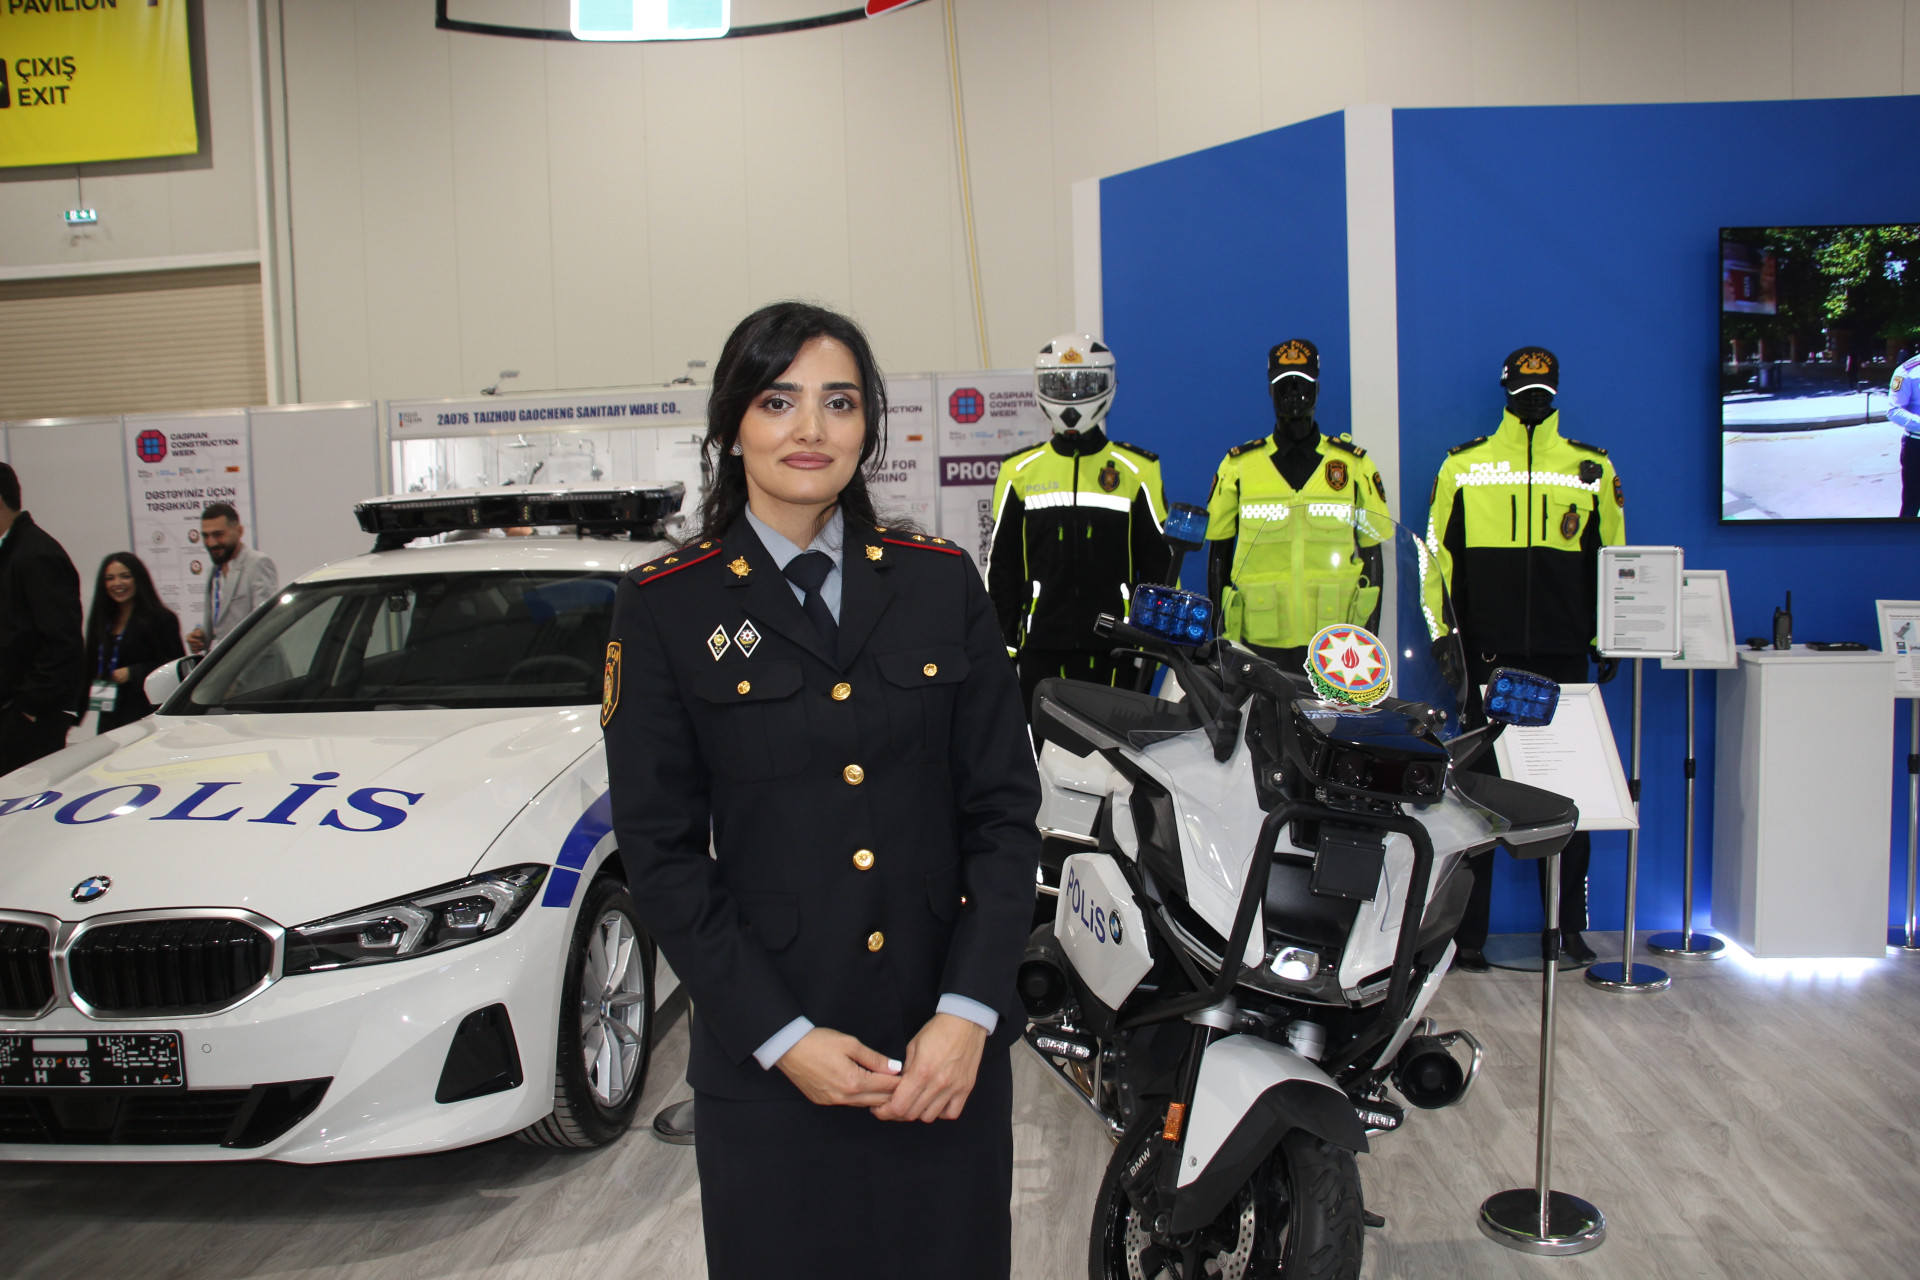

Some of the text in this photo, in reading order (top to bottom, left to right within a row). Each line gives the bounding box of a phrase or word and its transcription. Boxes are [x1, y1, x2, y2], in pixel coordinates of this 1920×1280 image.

[15, 56, 76, 84] ÇIXIŞ
[17, 85, 70, 106] EXIT
[989, 391, 1033, 400] CASPIAN
[886, 405, 922, 414] UCTION
[989, 400, 1037, 409] CONSTRU
[437, 412, 469, 427] 2A076
[473, 410, 517, 424] TAIZHOU
[518, 407, 574, 421] GAOCHENG
[576, 404, 627, 418] SANITARY
[629, 402, 659, 416] WARE
[990, 409, 1017, 417] WEEK
[170, 432, 209, 441] CASPIAN
[170, 438, 239, 449] CONSTRUCTION
[171, 448, 196, 457] WEEK
[891, 459, 917, 470] FOR
[946, 460, 1002, 480] PROG
[1129, 1147, 1151, 1177] BMW
